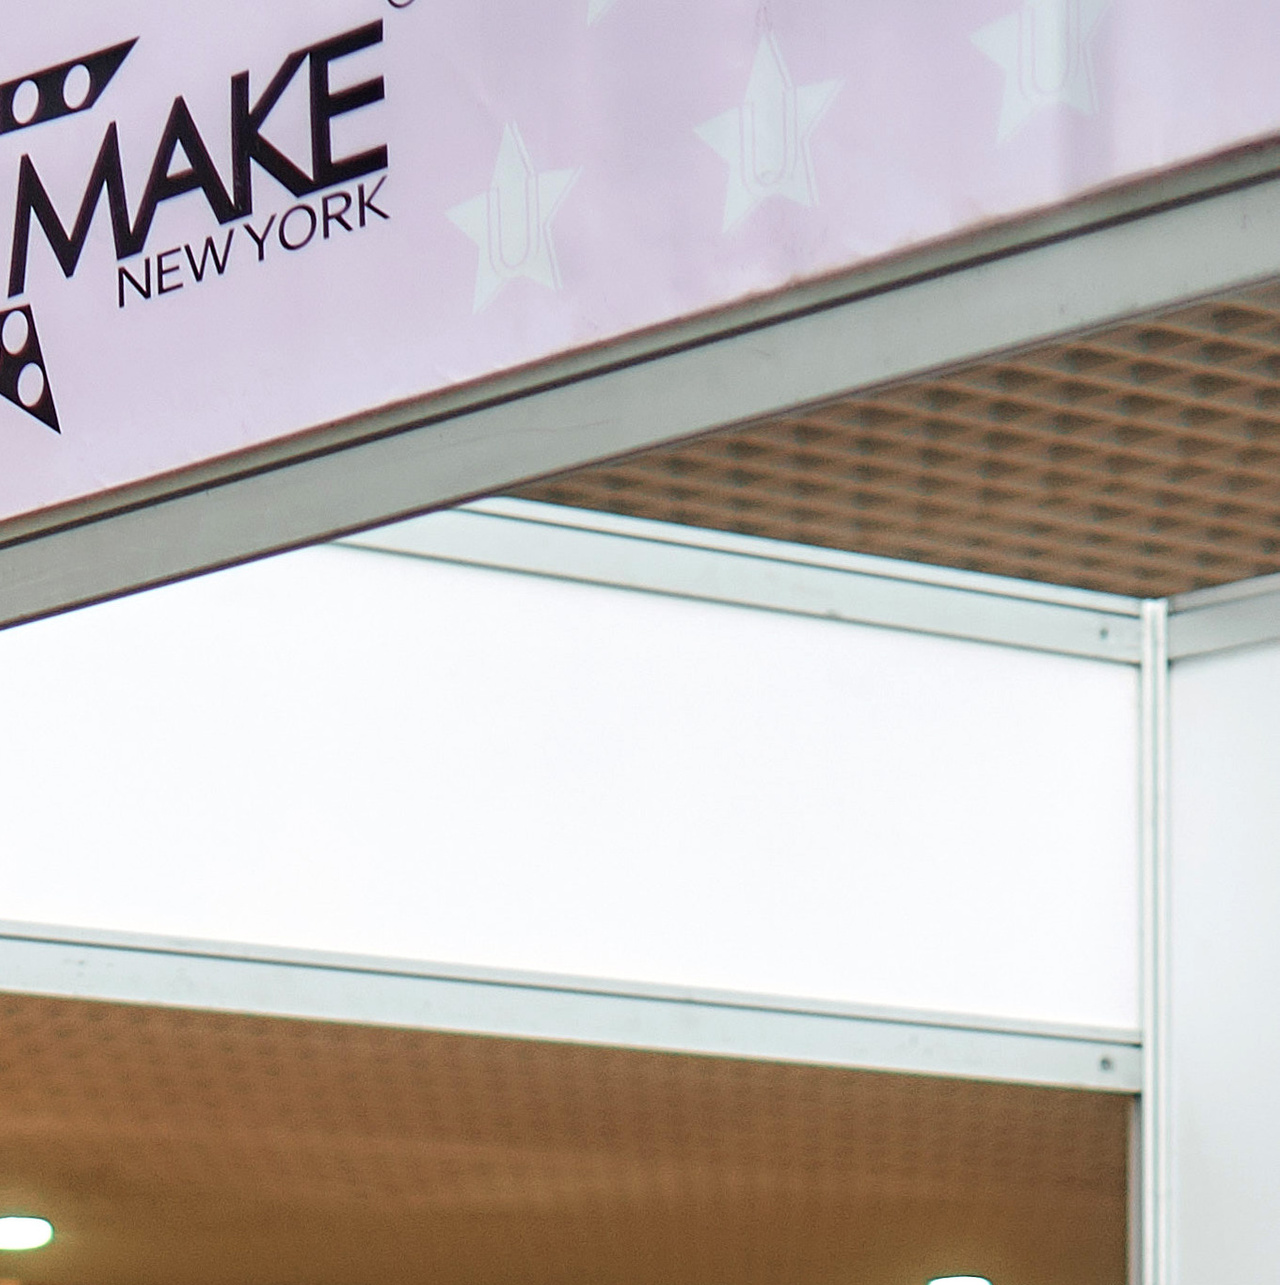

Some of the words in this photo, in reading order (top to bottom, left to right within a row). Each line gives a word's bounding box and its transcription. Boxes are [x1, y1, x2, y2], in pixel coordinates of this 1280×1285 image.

[8, 20, 389, 298] MAKE
[118, 228, 235, 308] NEW
[242, 174, 390, 262] YORK
